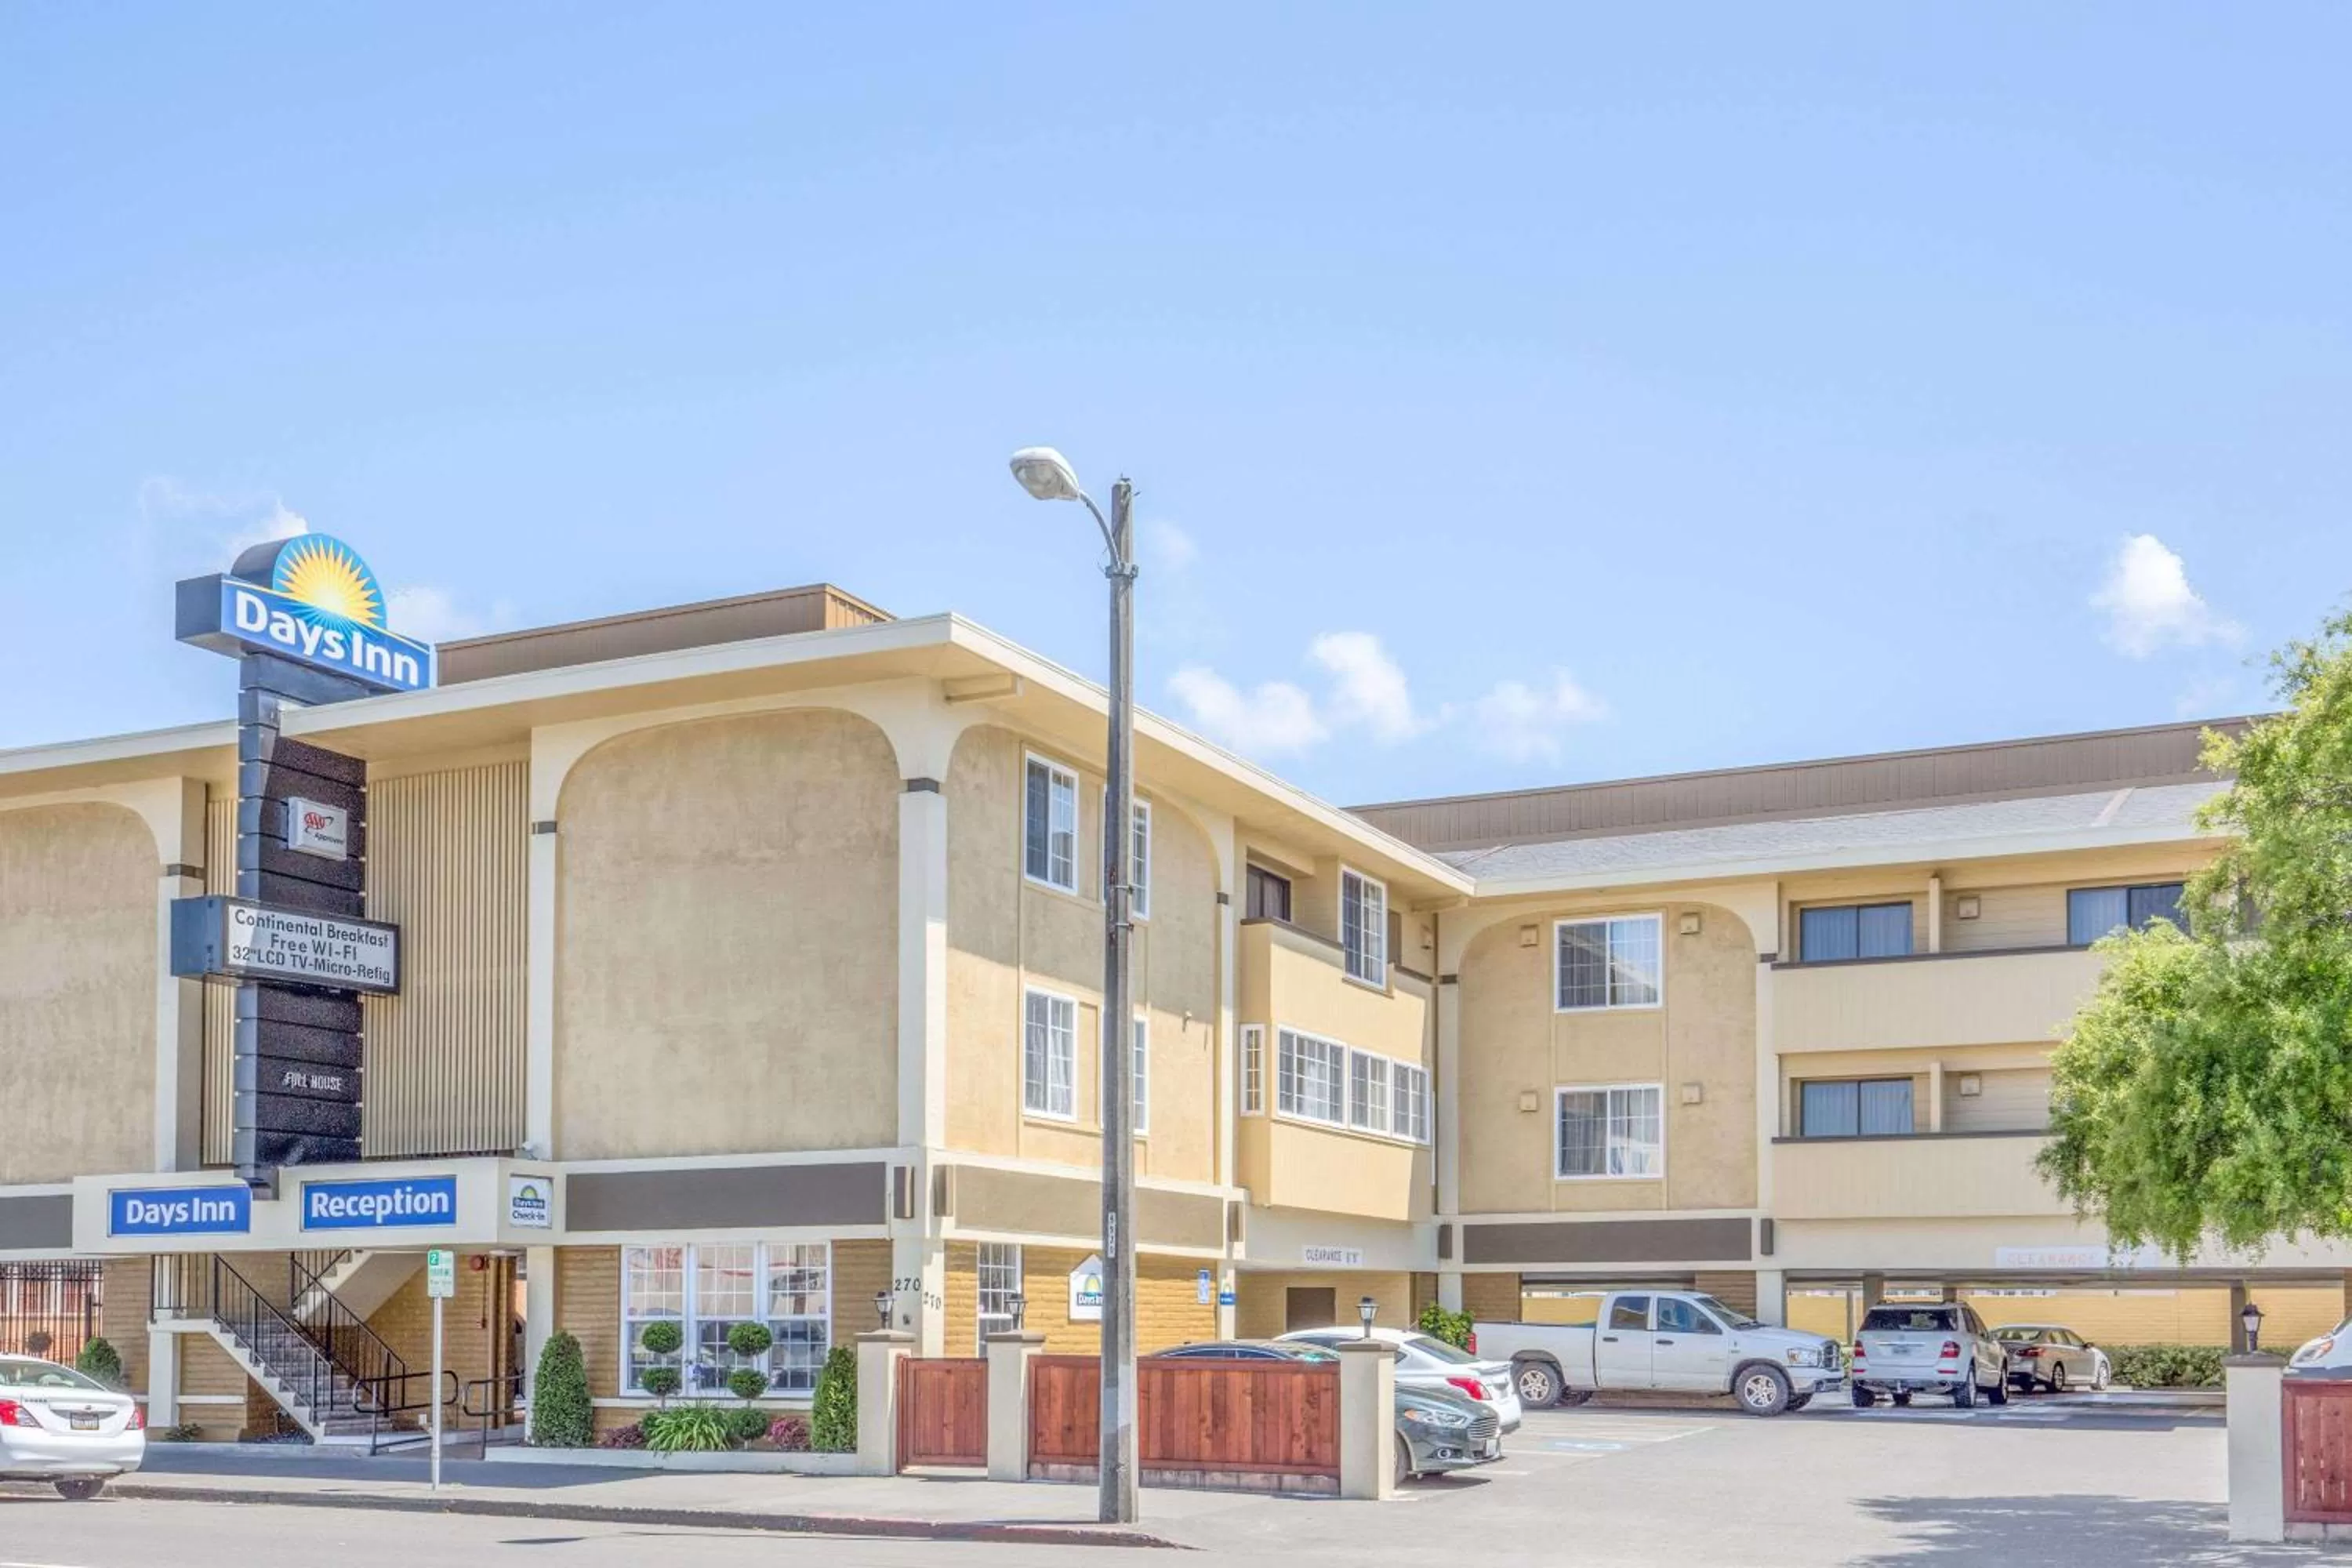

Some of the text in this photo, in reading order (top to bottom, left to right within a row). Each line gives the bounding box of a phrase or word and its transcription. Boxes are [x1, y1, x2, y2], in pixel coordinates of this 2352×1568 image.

[236, 590, 419, 687] Days Inn
[304, 811, 325, 830] AAA
[234, 909, 388, 947] Continental Breakfast
[270, 933, 308, 953] Free
[126, 1196, 235, 1226] Days Inn
[311, 1186, 449, 1224] Reception
[895, 1277, 921, 1291] 270
